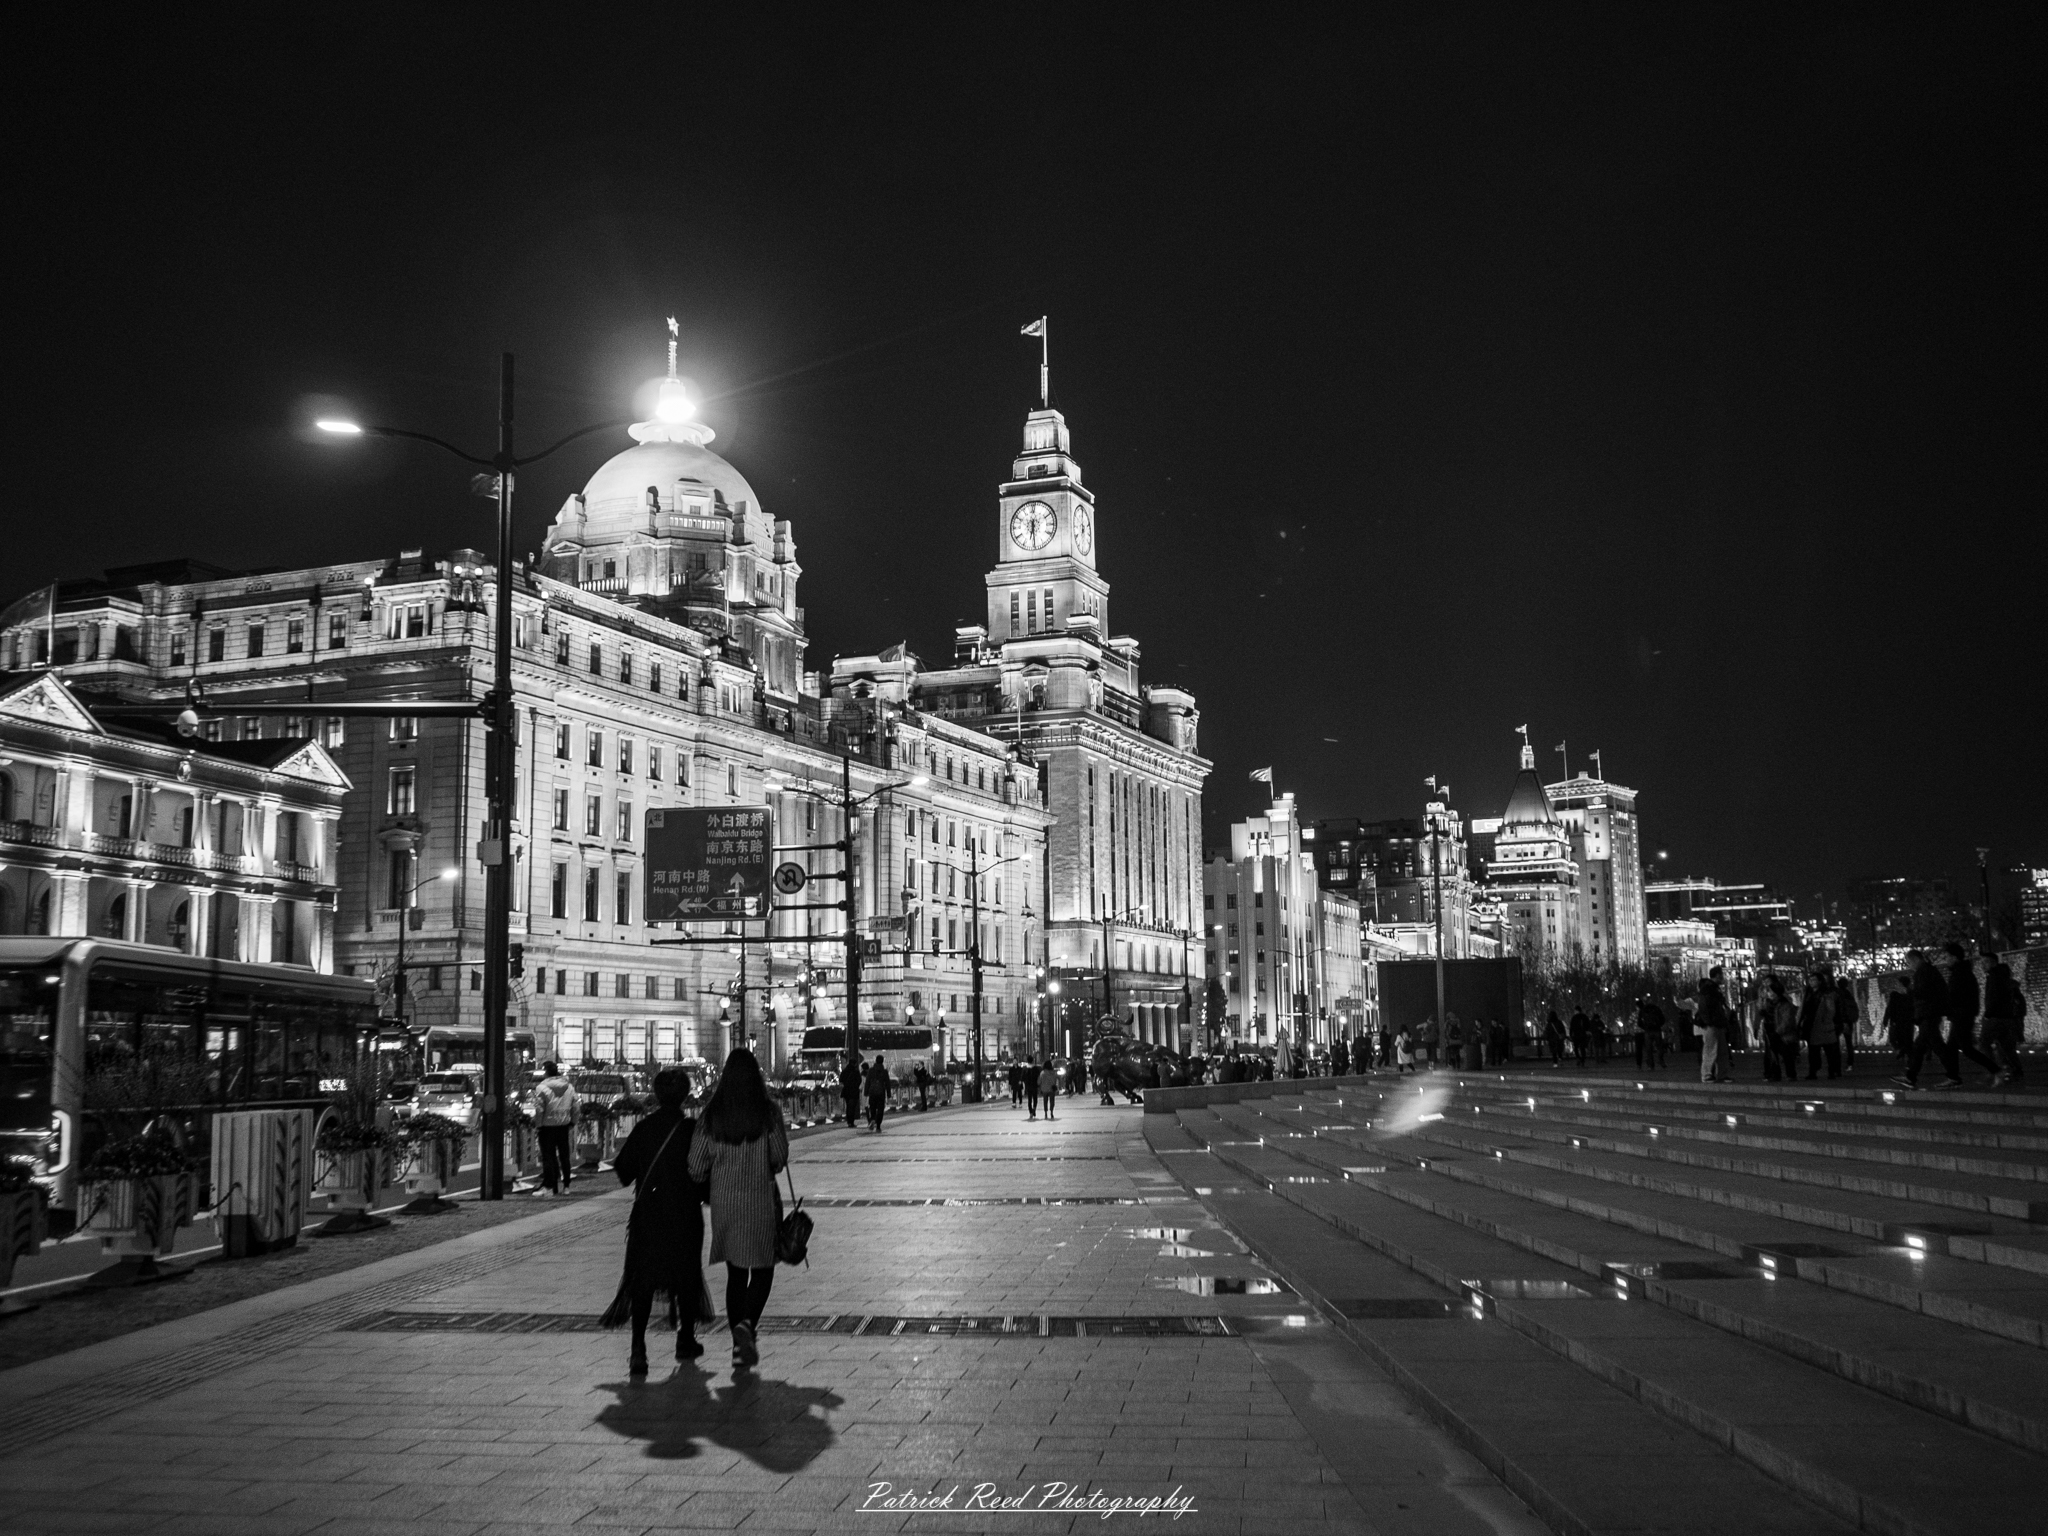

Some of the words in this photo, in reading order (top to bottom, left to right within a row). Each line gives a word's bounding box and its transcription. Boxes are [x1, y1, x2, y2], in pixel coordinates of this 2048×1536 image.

[654, 813, 663, 822] 北
[707, 812, 764, 828] 外白渡桥
[740, 829, 763, 839] Bridge
[706, 839, 764, 855] 南京东路
[706, 856, 737, 866] Nanjing
[653, 869, 710, 884] 河南中路
[653, 886, 680, 894] Henan
